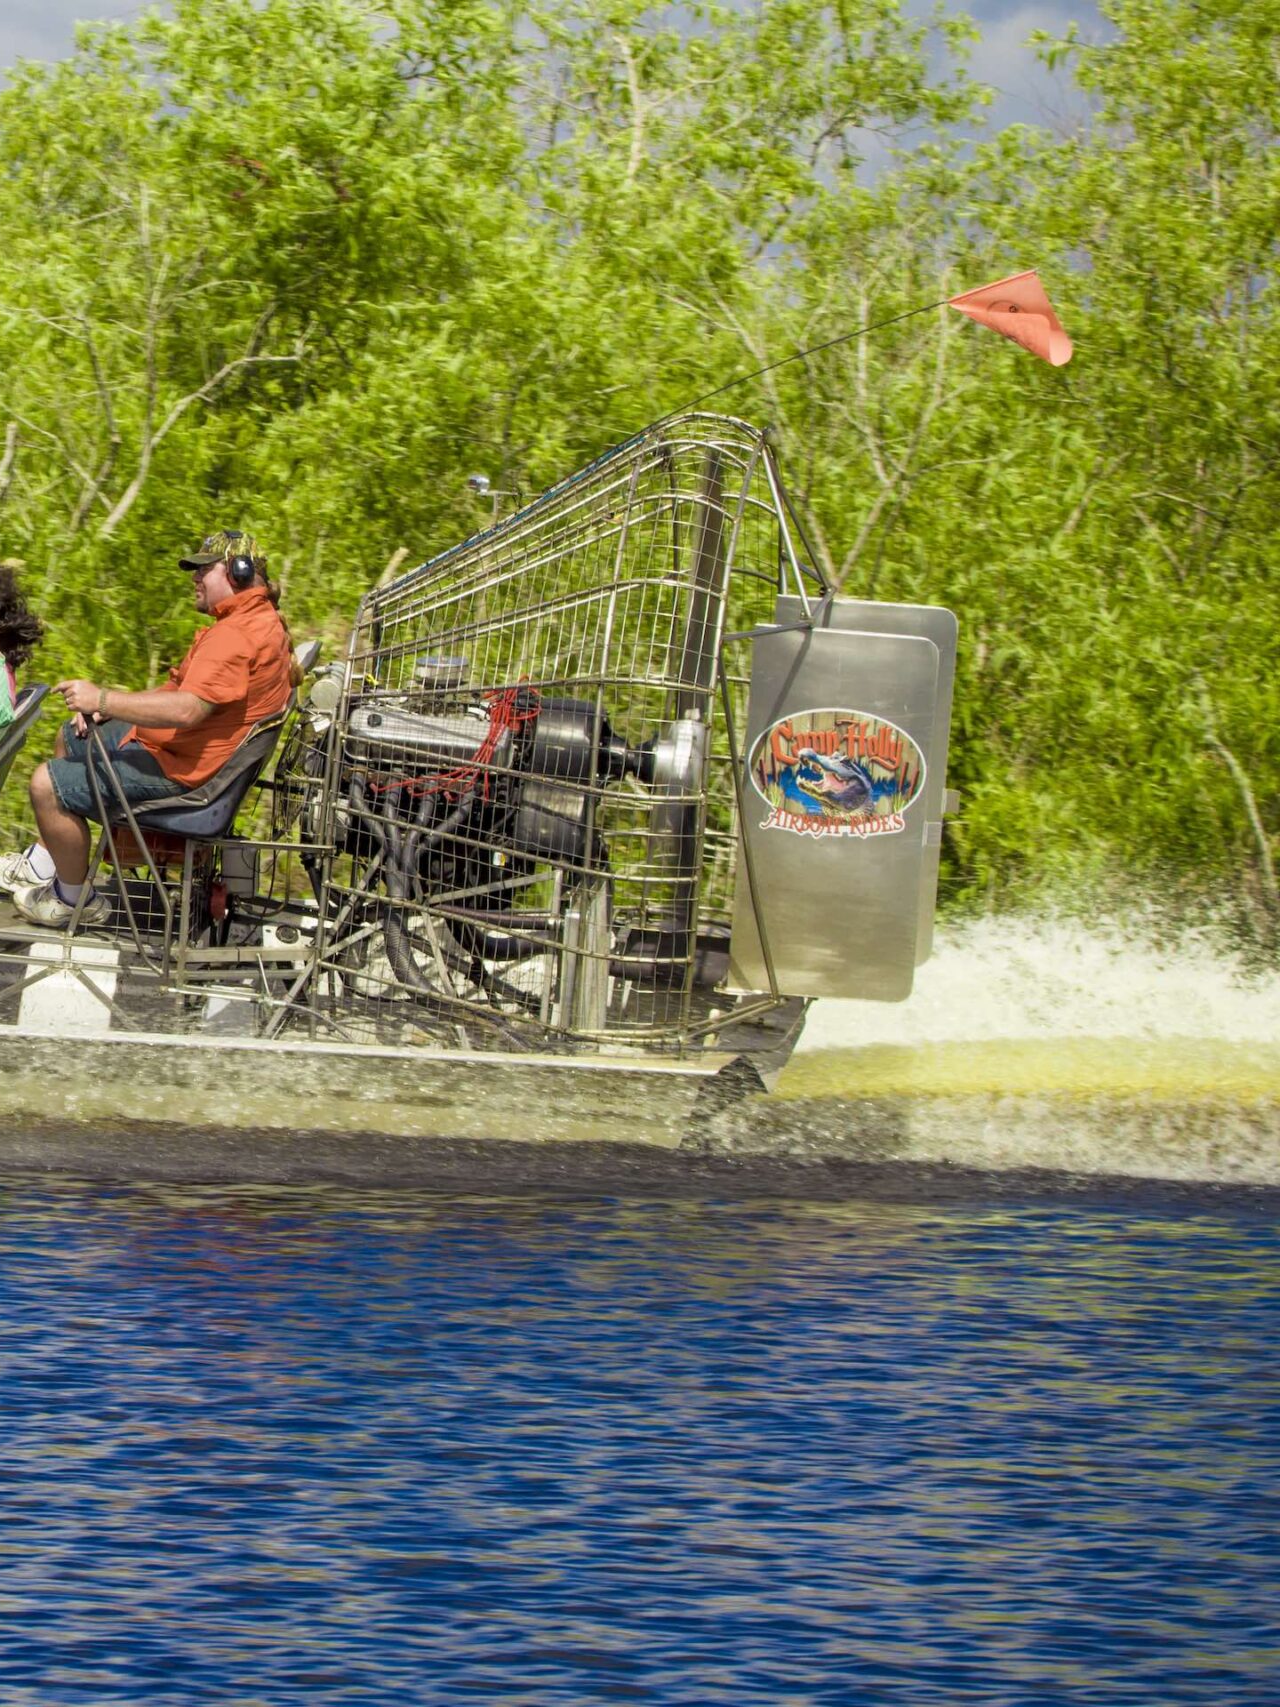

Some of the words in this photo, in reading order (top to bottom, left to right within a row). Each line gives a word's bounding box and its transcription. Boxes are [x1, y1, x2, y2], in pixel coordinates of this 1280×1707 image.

[771, 719, 840, 766] Camp
[836, 719, 903, 771] Holly
[763, 807, 841, 837] AIRBOAT
[849, 813, 904, 837] RIDES
